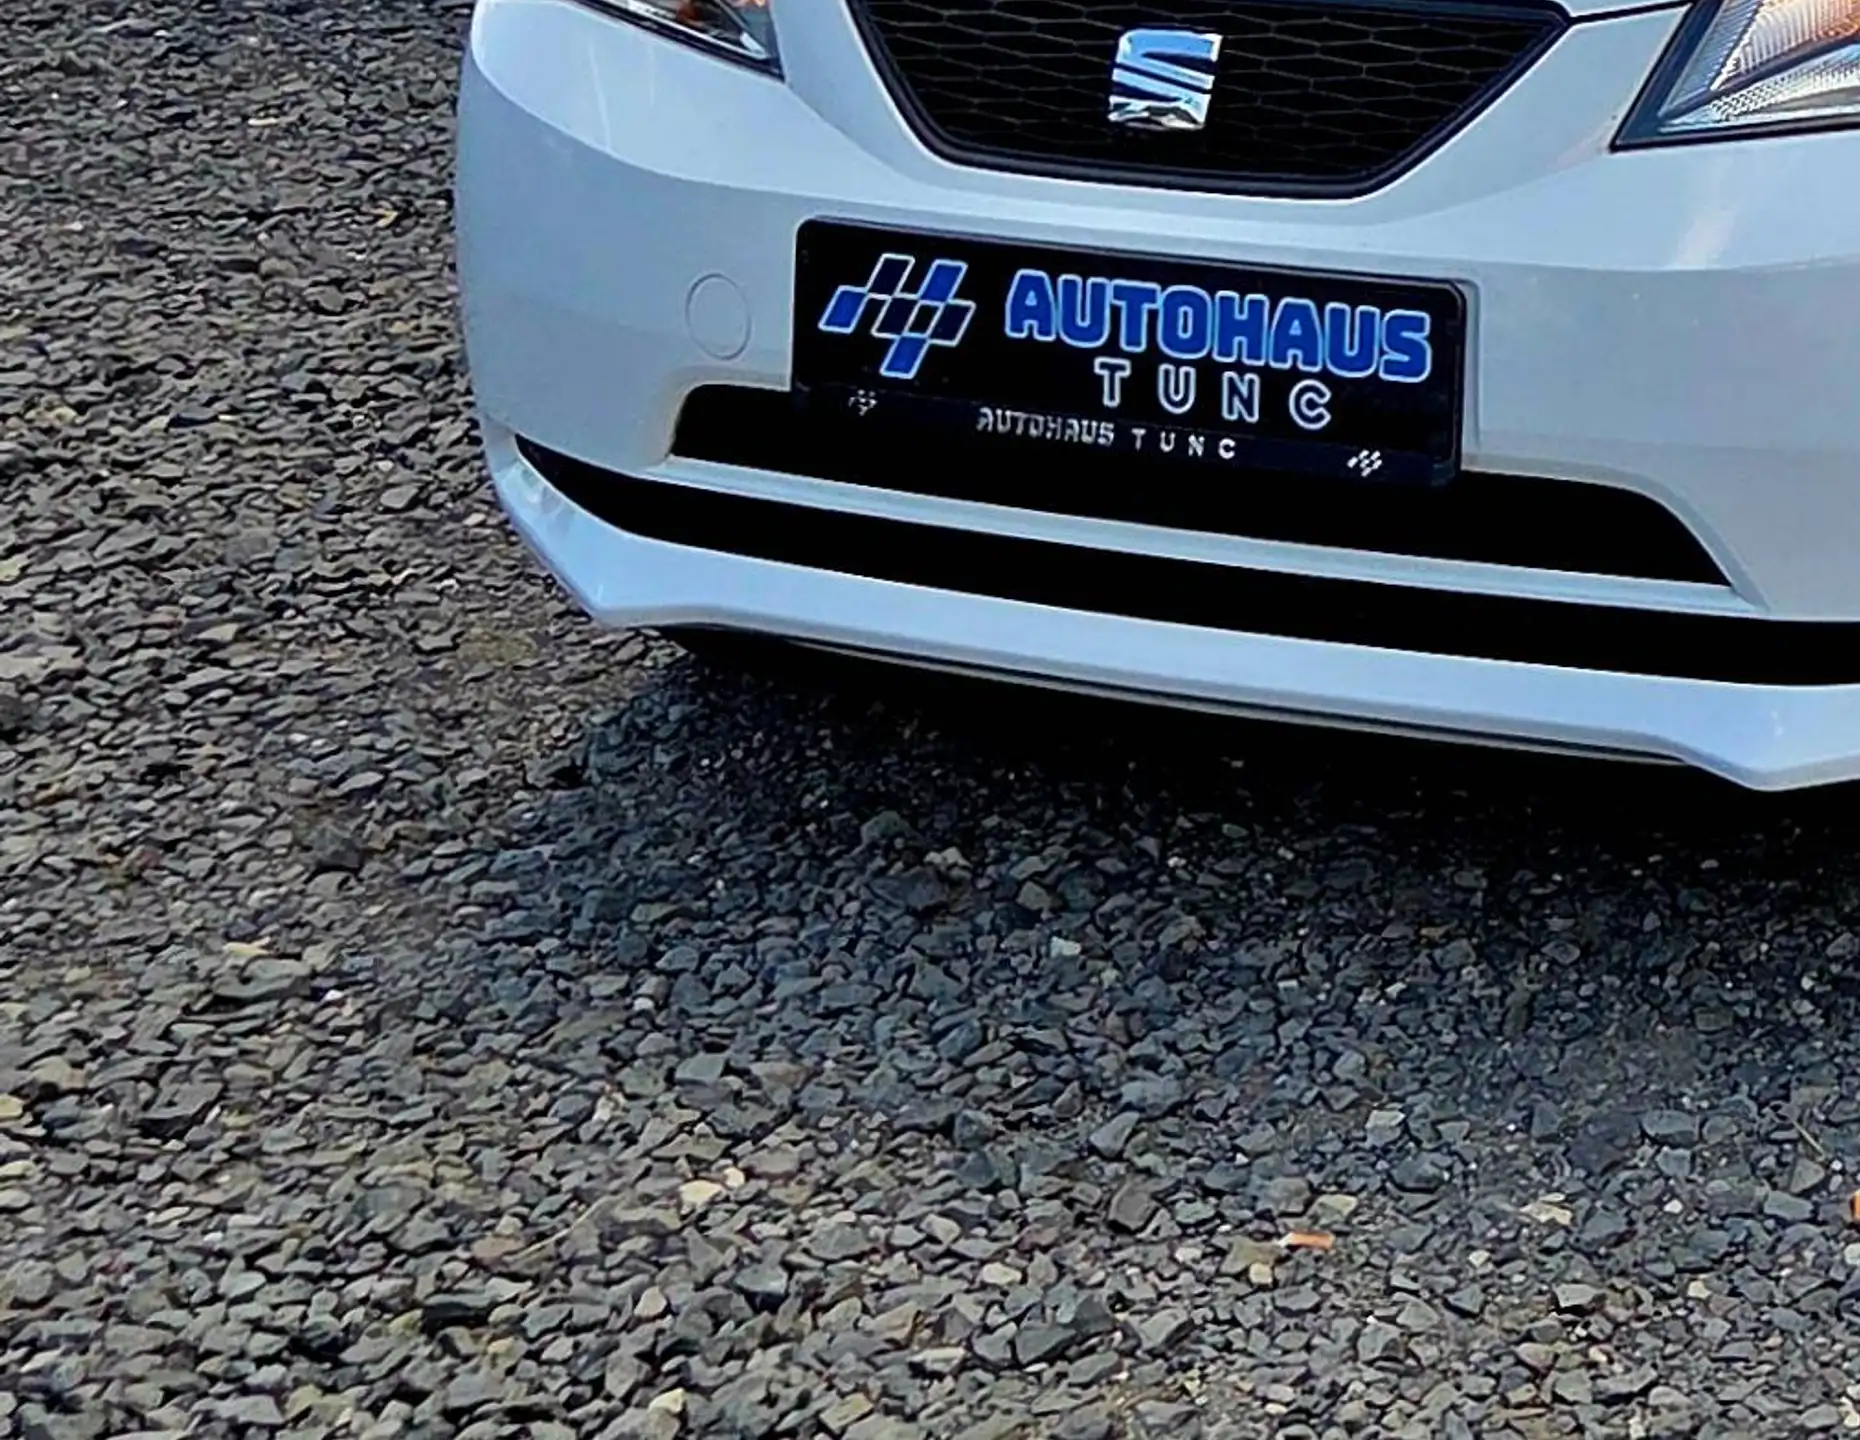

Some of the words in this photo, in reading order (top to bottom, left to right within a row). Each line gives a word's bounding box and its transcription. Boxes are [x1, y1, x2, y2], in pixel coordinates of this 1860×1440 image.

[1005, 270, 1432, 383] AUTOHAUS
[1096, 359, 1332, 430] TUNC
[976, 407, 1116, 446] AUTOHAUS
[1133, 428, 1236, 459] TUNC
